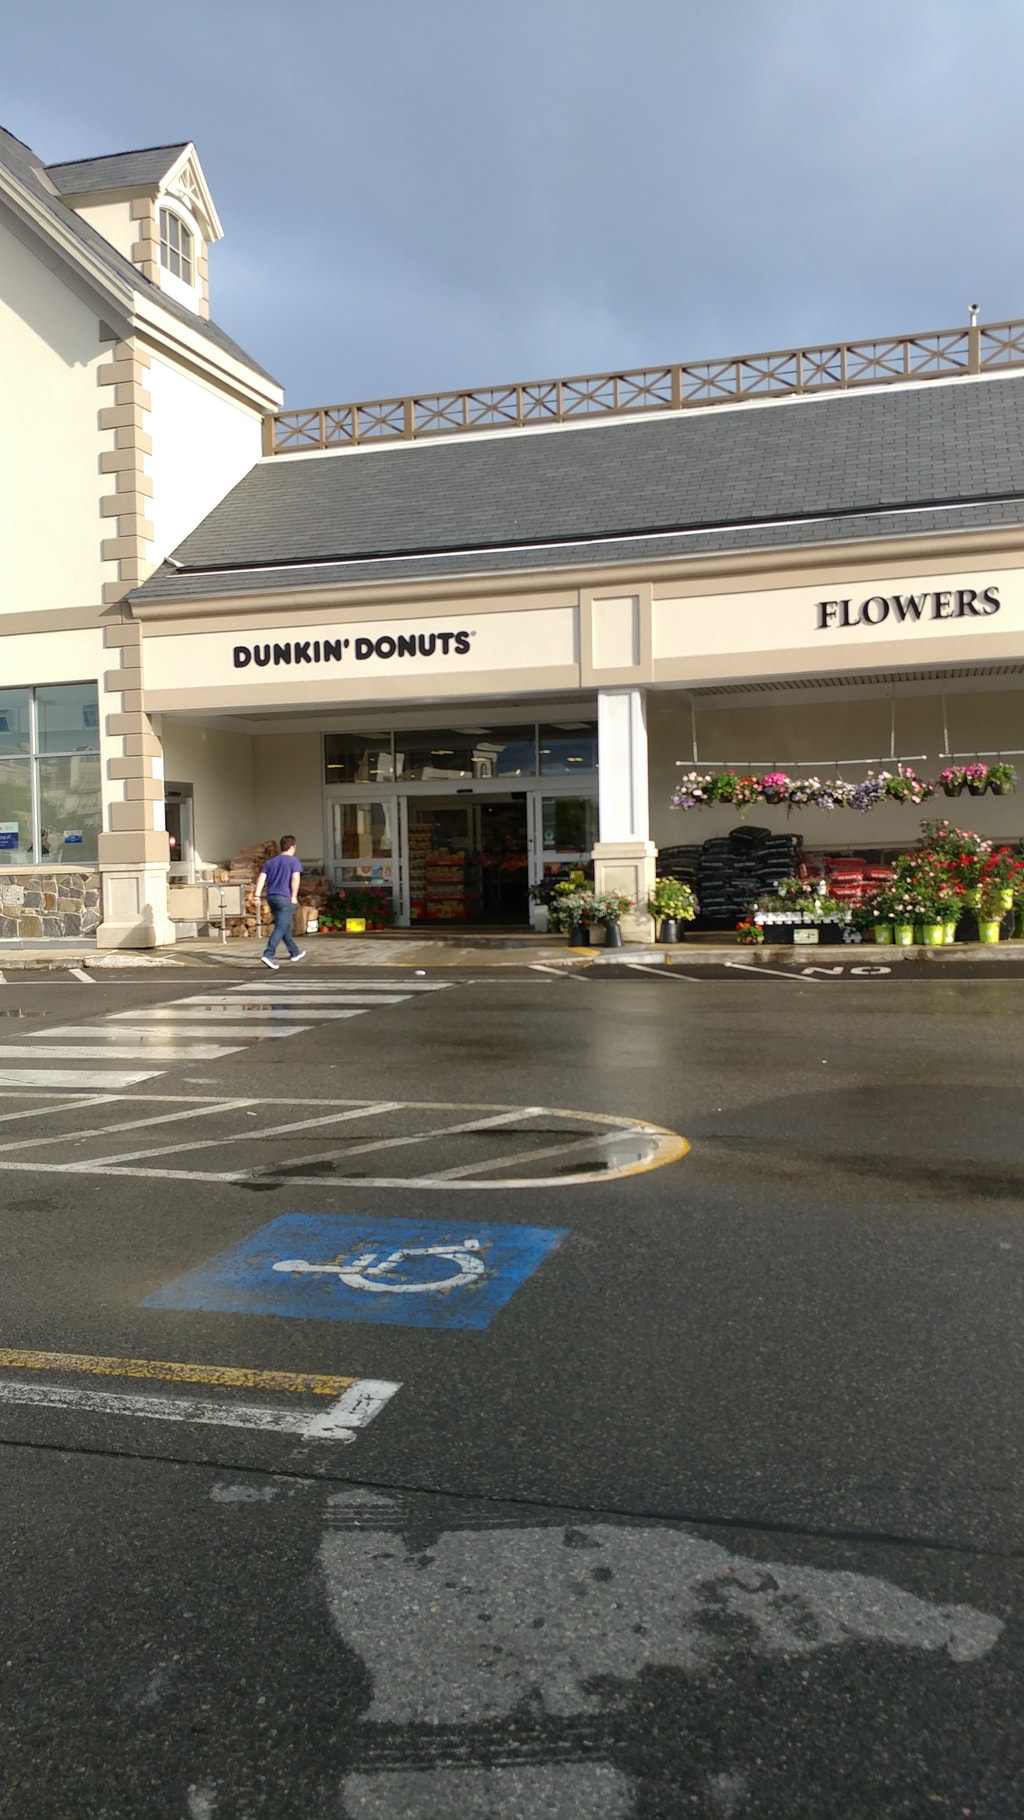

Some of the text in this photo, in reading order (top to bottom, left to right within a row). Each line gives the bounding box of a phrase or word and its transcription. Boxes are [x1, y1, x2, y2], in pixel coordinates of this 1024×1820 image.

[816, 586, 1001, 630] FLOWERS
[233, 631, 471, 668] DUNKIN' DONUTS
[801, 966, 892, 975] NO
